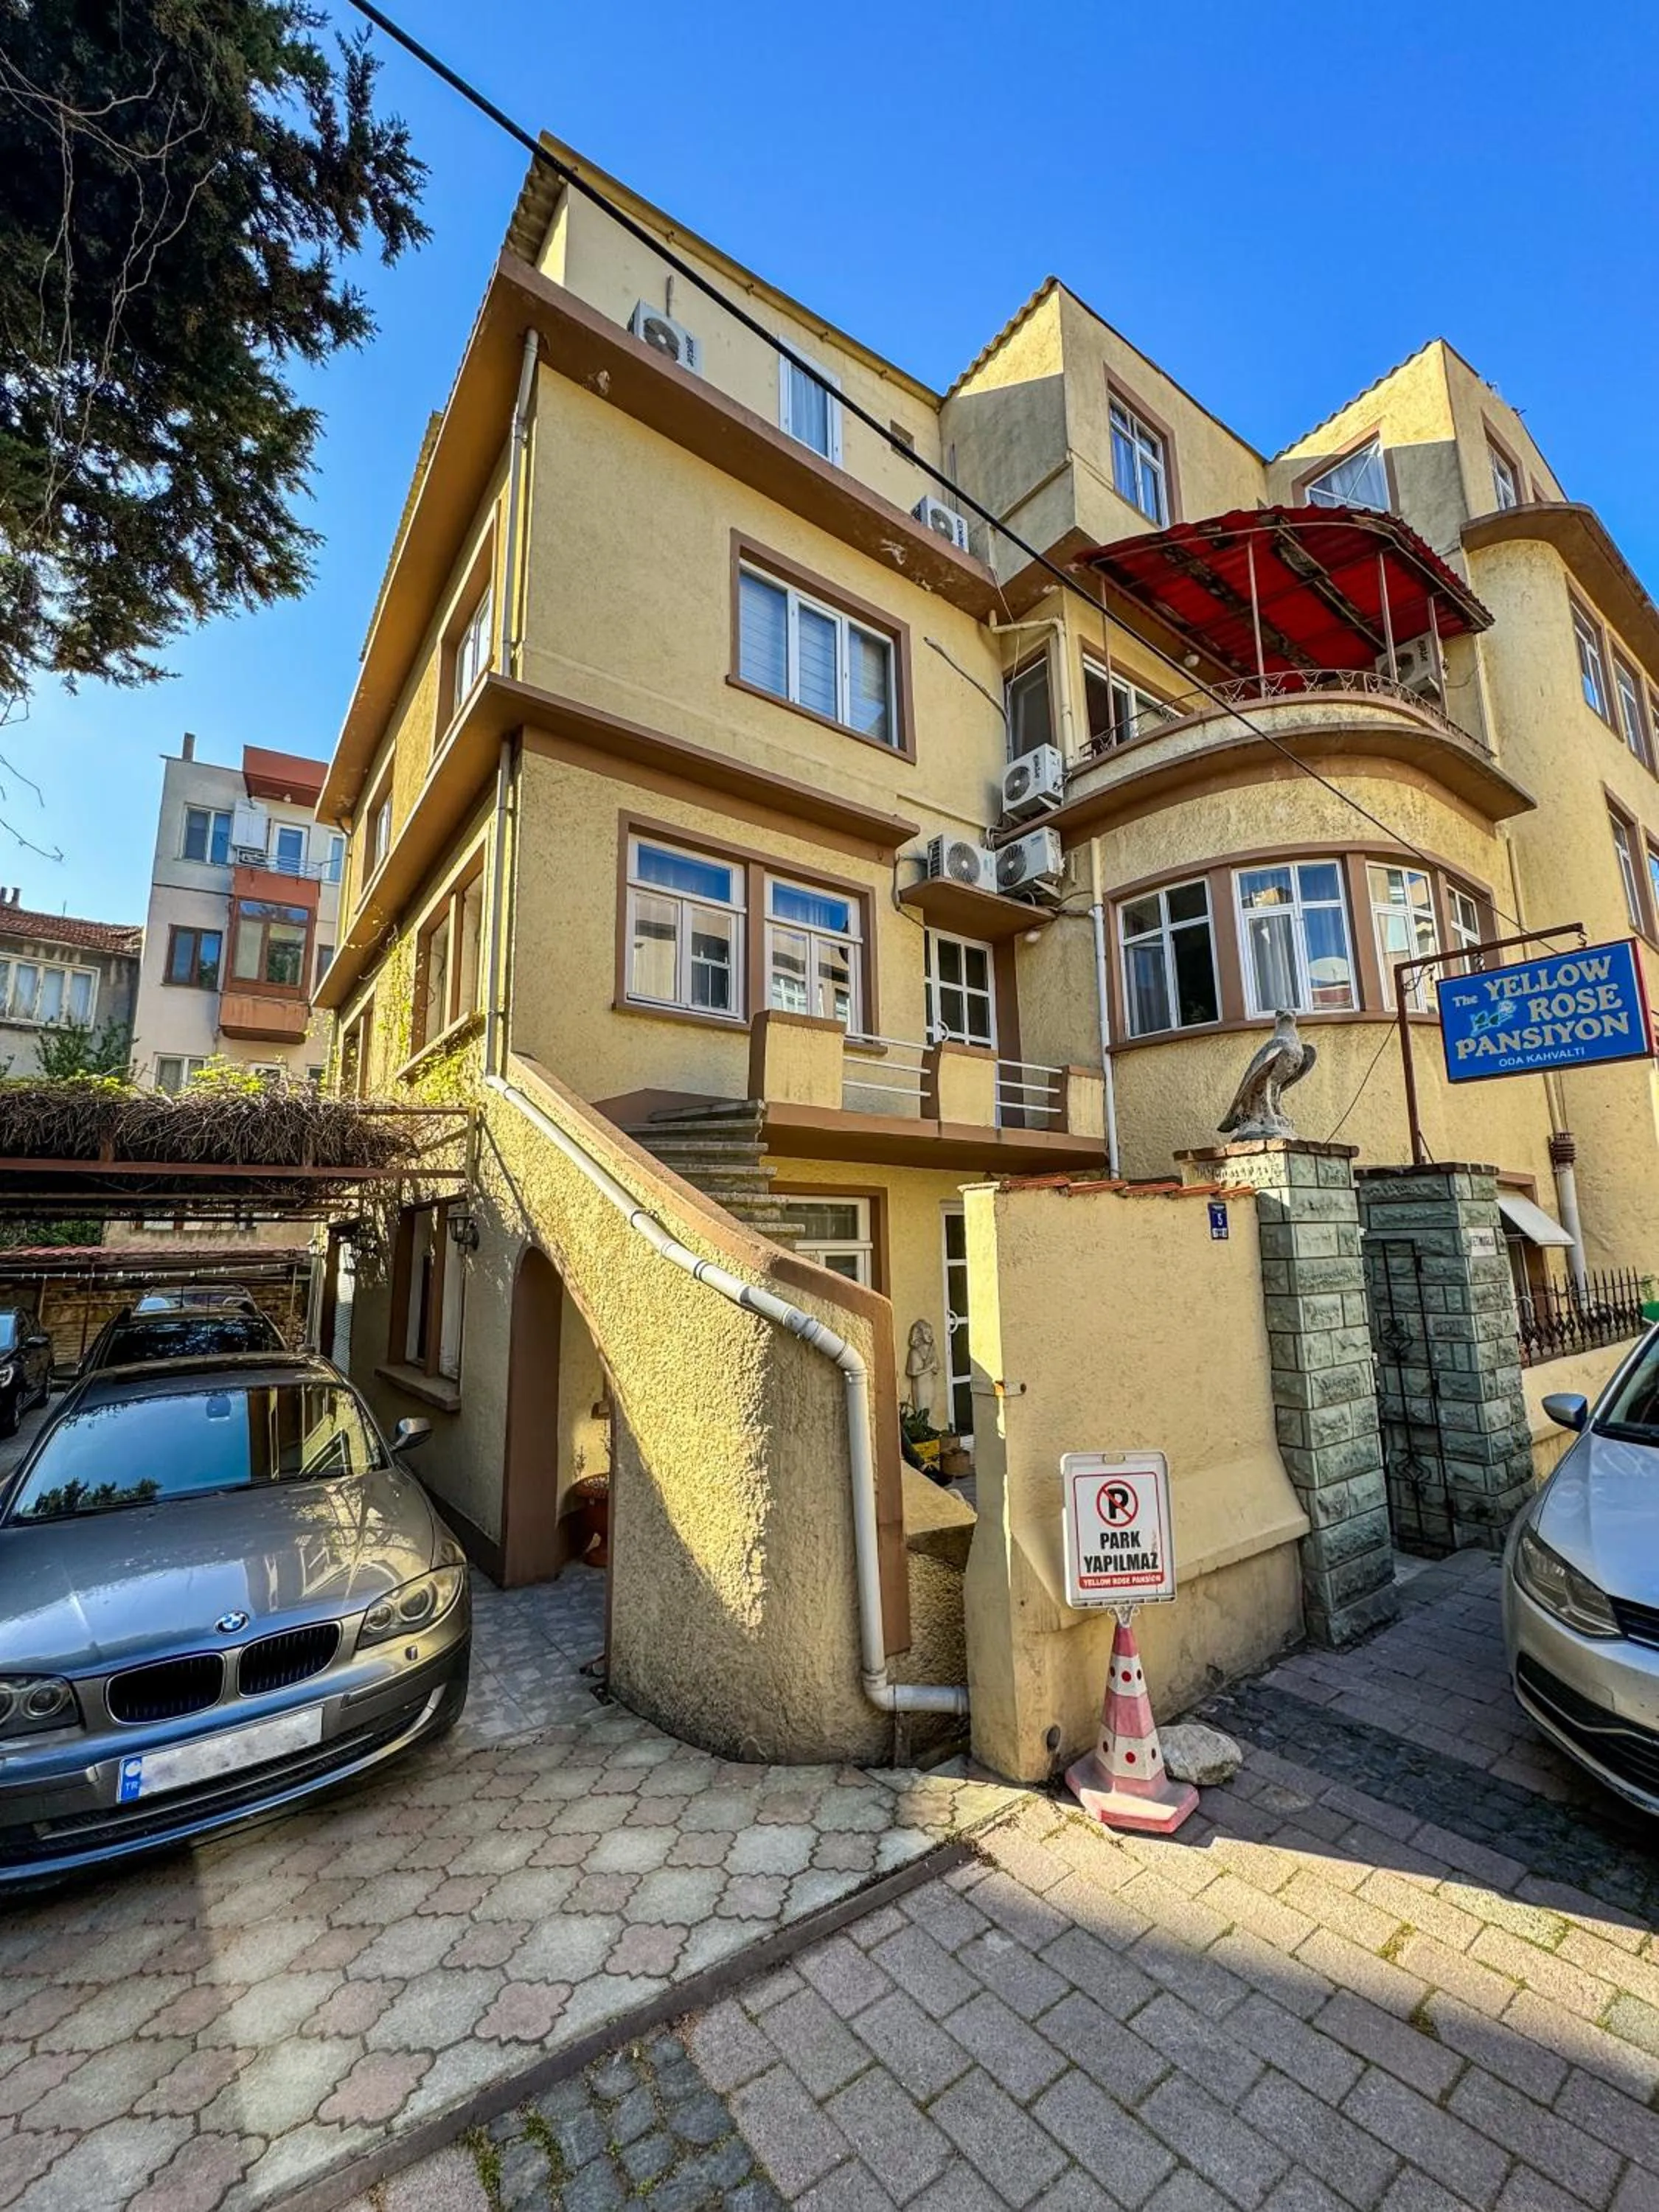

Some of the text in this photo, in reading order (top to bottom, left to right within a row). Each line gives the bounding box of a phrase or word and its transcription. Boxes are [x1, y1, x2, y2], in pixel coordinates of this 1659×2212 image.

[1484, 955, 1612, 1001] YELLOW
[1527, 983, 1623, 1023] ROSE
[1455, 1011, 1629, 1060] PANSIYON
[1498, 1046, 1585, 1067] ODA KAHVALTI
[1099, 1530, 1141, 1549] PARK
[1083, 1552, 1159, 1573] YAPILMAZ
[126, 1781, 139, 1791] TR
